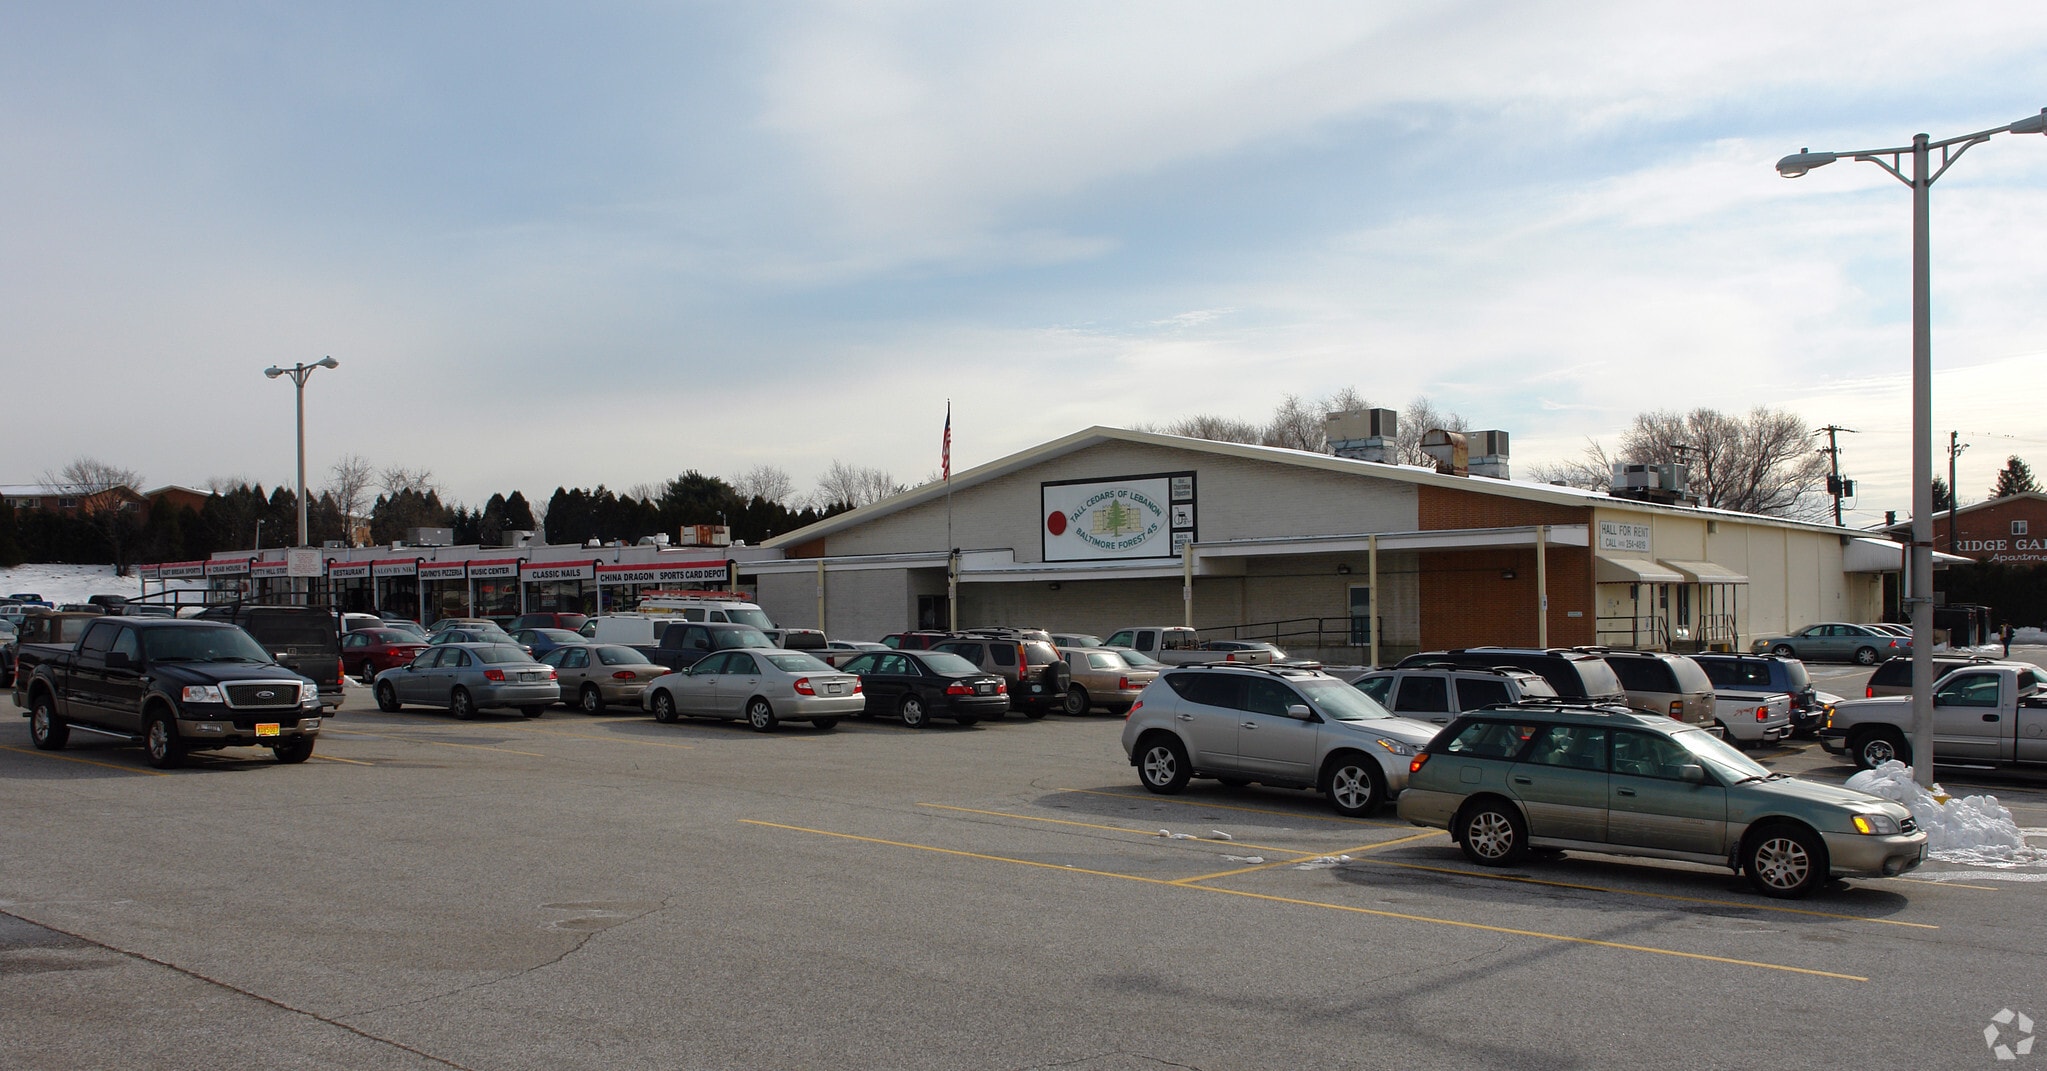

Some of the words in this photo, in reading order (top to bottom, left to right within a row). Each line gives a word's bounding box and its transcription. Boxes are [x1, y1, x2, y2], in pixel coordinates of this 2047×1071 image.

[1070, 505, 1087, 523] TALL
[1086, 490, 1115, 507] CEDARS
[1117, 490, 1128, 498] OF
[1130, 491, 1162, 517] LEBANON
[1075, 527, 1116, 550] BALTIMORE
[1118, 532, 1147, 549] FOREST
[1147, 522, 1158, 535] 45
[1602, 524, 1617, 535] HALL
[1619, 525, 1632, 536] FOR
[1634, 527, 1648, 538] RENT
[1605, 538, 1616, 547] CALL
[185, 566, 200, 574] SPORTS
[212, 565, 225, 573] CRAB
[226, 564, 241, 572] HOUSE
[333, 567, 365, 577] RESTAURANT
[442, 568, 463, 577] PIZZERIA
[470, 568, 488, 576] MUSIC
[488, 567, 510, 575] CENTER
[532, 570, 560, 579] CLASSIC
[560, 568, 581, 577] NAILS
[600, 574, 622, 582] CHINA
[623, 572, 655, 581] DRAGON
[659, 571, 684, 580] SPORTS
[685, 570, 703, 579] CARD
[704, 569, 726, 578] DEPOT
